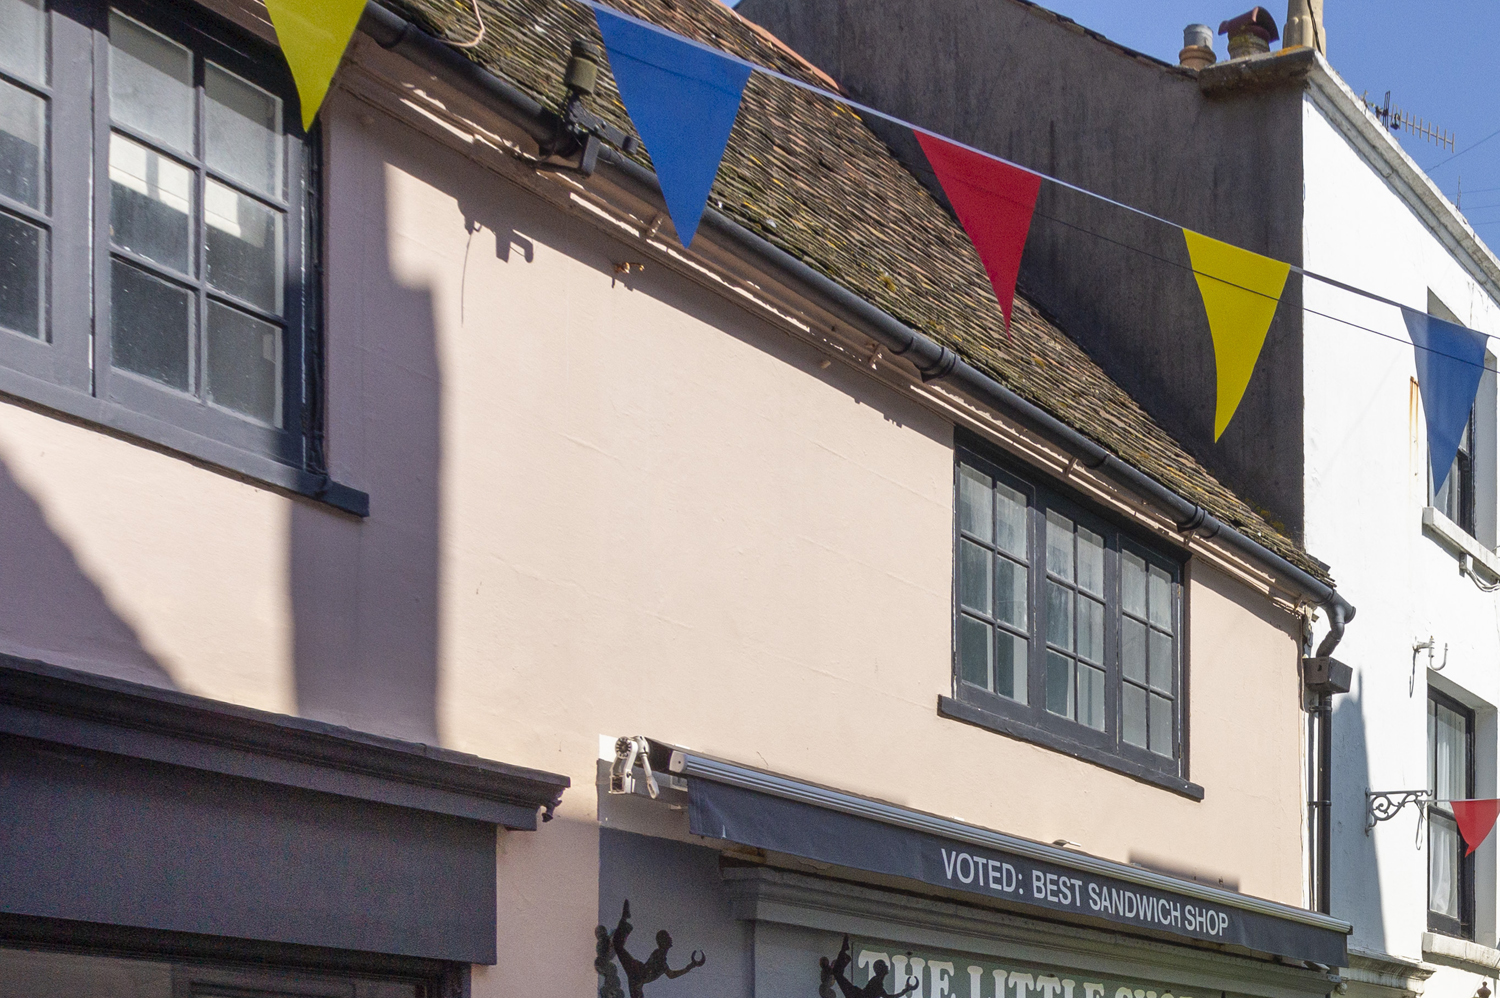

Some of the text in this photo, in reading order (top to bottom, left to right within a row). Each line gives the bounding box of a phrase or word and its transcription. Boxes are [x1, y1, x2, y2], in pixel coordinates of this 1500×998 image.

[940, 848, 1229, 938] VOTED: BEST SANDWICH SHOP
